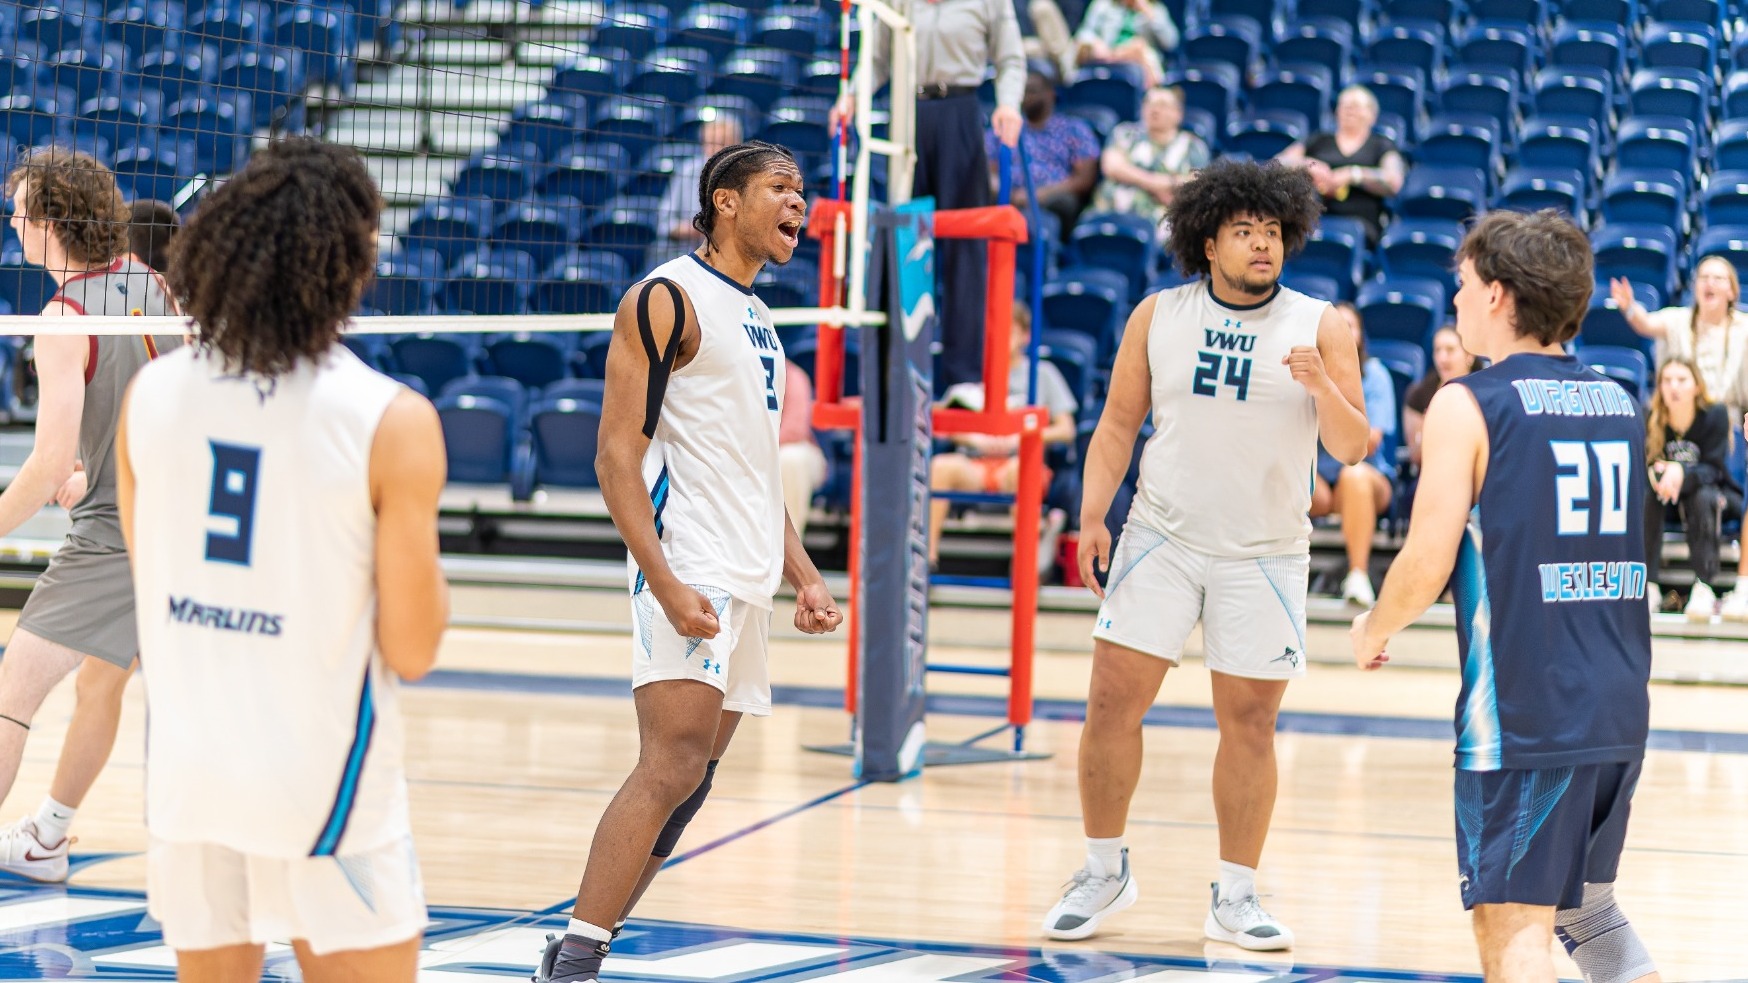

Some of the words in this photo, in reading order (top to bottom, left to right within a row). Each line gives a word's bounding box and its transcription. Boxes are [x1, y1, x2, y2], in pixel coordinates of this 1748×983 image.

[742, 323, 778, 351] VWU
[1204, 328, 1257, 353] VWU
[759, 354, 779, 411] 3
[1192, 350, 1252, 401] 24
[1511, 379, 1635, 417] VIRGINIA
[204, 439, 262, 566] 9
[1549, 440, 1631, 536] 20
[1538, 561, 1647, 602] WESLEYN
[168, 595, 282, 637] MARLINS
